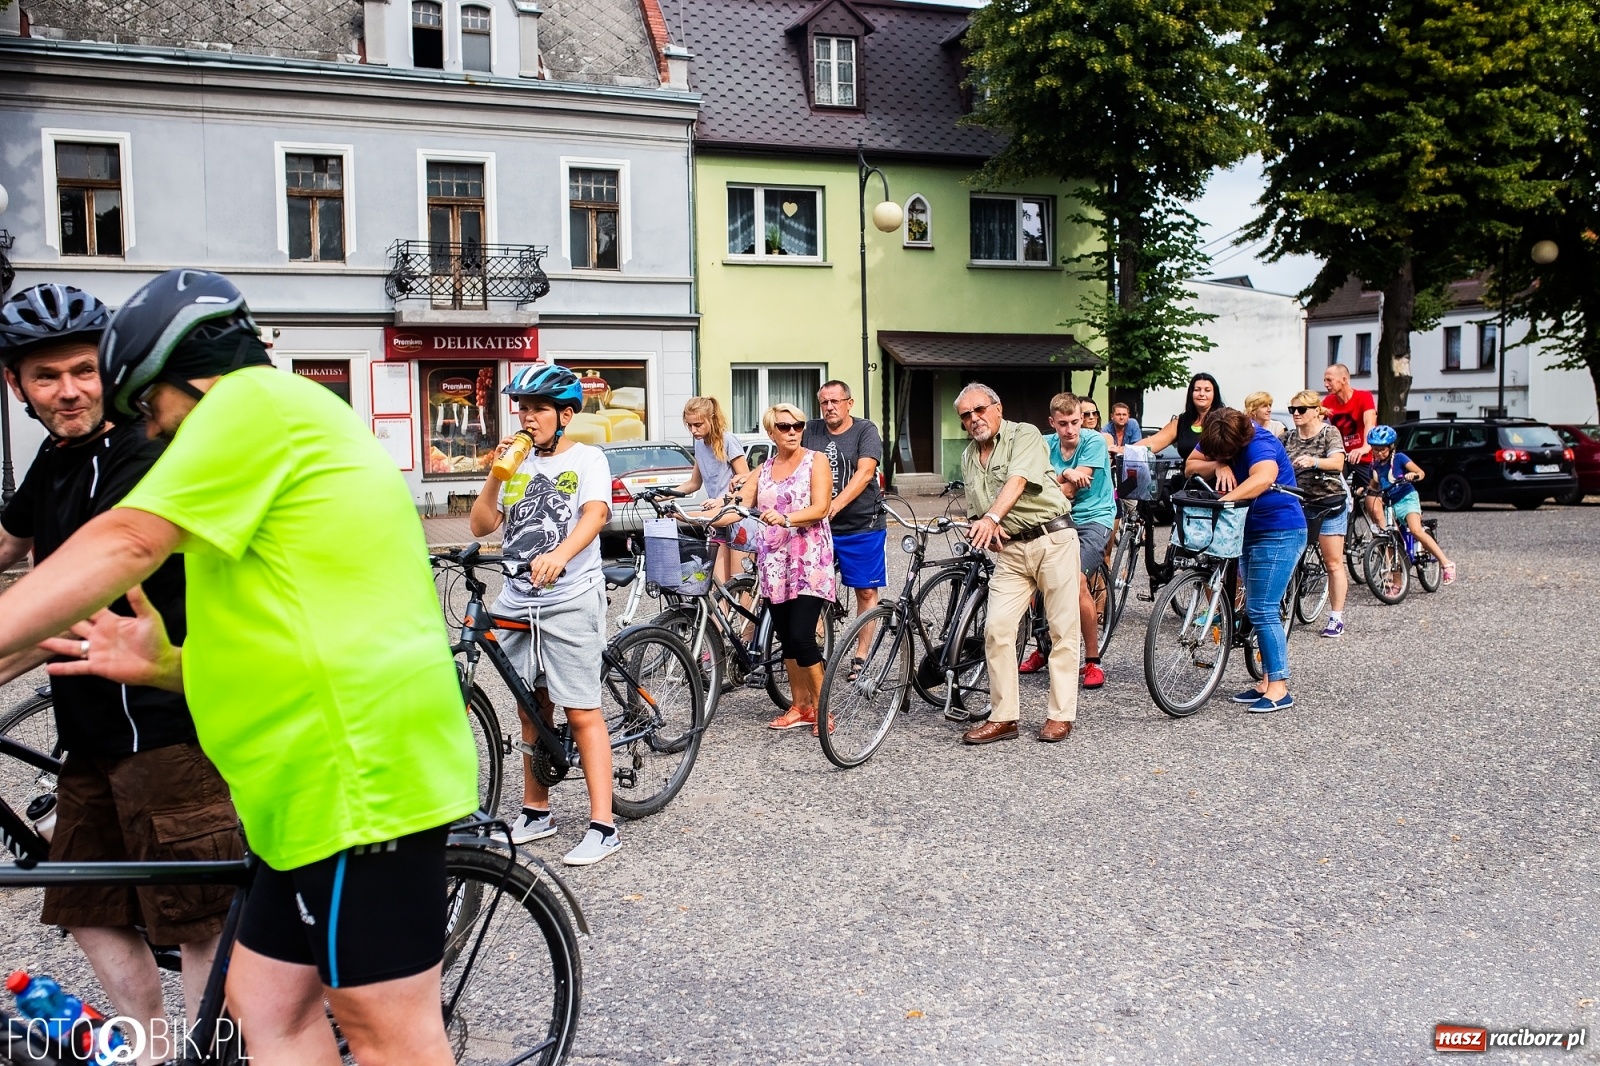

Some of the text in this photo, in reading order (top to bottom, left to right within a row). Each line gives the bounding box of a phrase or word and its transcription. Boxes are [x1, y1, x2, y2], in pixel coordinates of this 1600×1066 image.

[393, 338, 423, 346] Premium
[433, 336, 534, 350] DELIKATESY
[295, 368, 344, 376] DELIKATESY
[442, 382, 472, 391] Premium
[581, 381, 605, 389] remium
